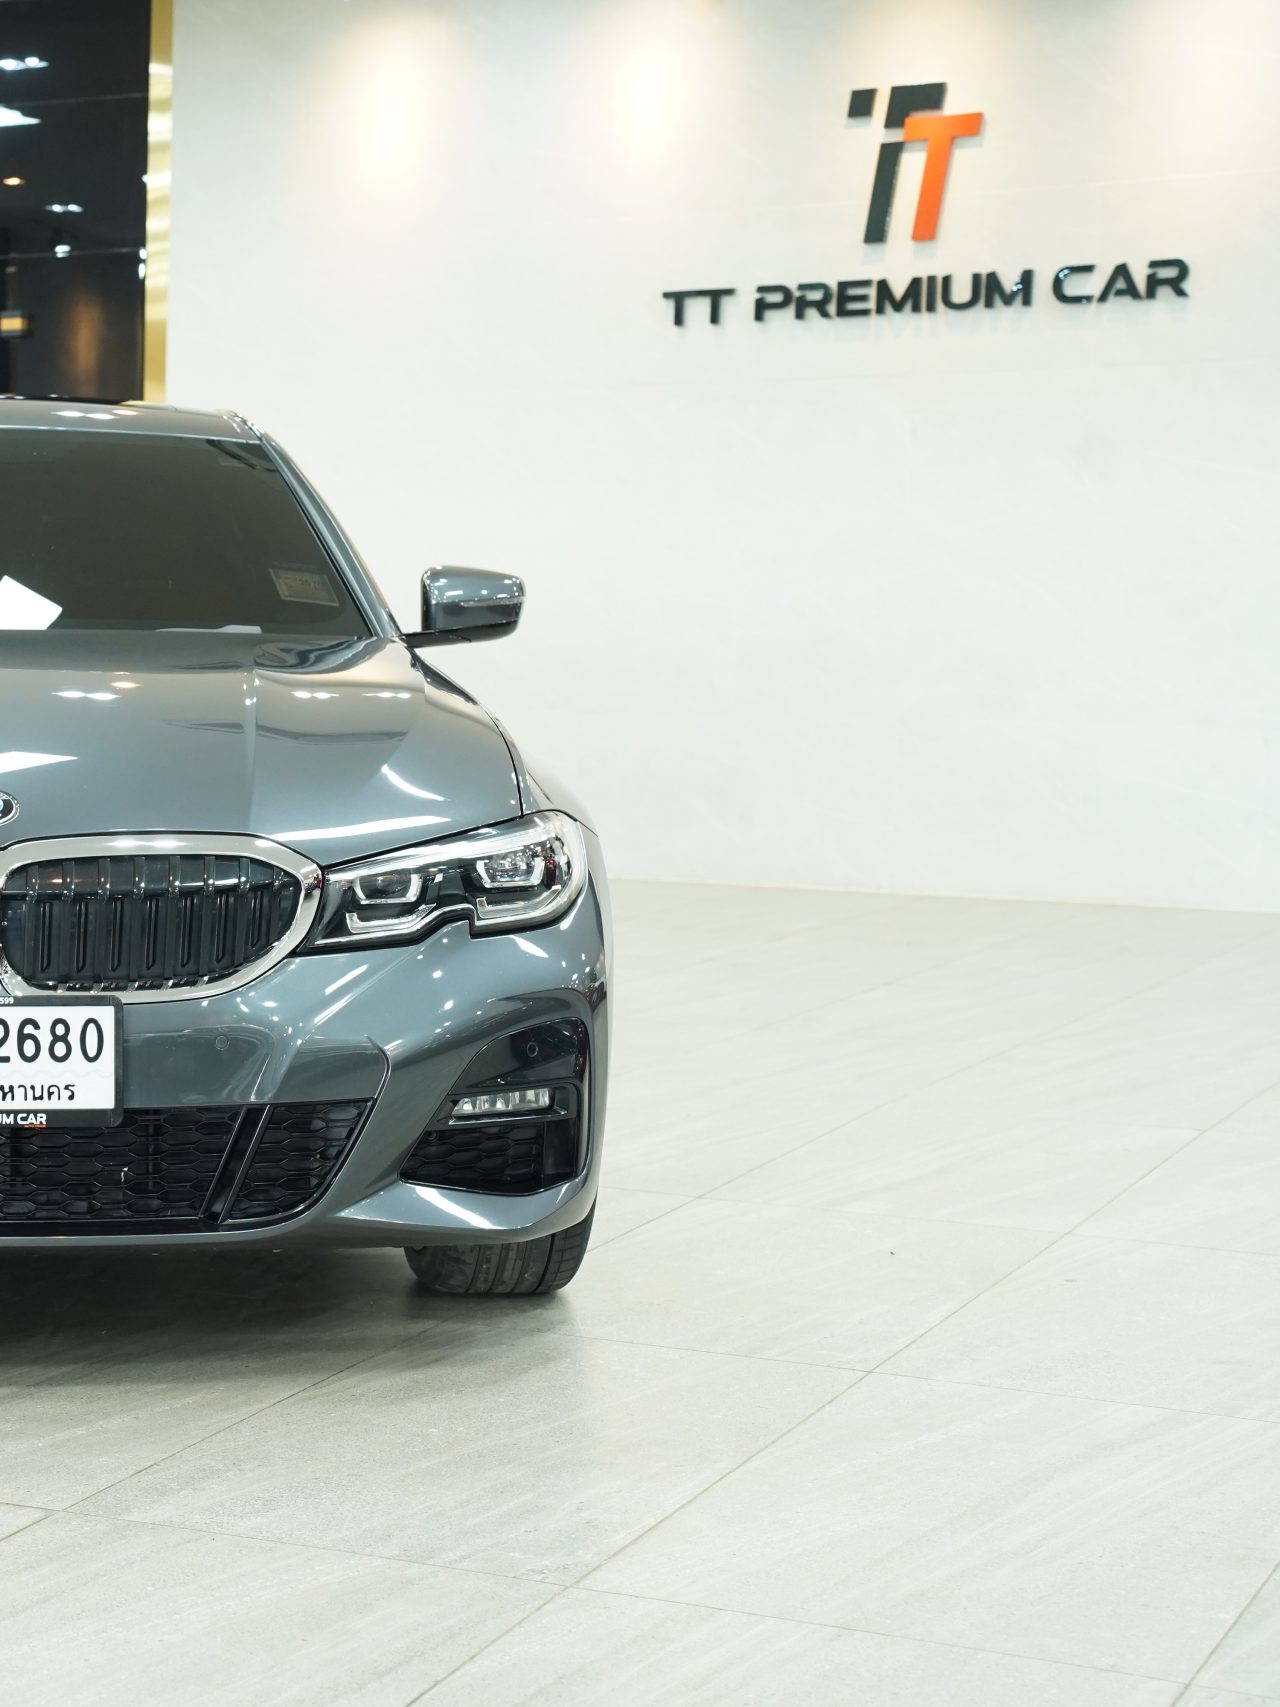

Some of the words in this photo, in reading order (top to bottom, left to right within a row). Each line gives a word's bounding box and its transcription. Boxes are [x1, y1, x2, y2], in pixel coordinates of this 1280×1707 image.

[663, 288, 736, 327] TT
[754, 269, 1034, 322] PREMIUM
[1052, 258, 1190, 304] CAR
[17, 1113, 47, 1125] CAR
